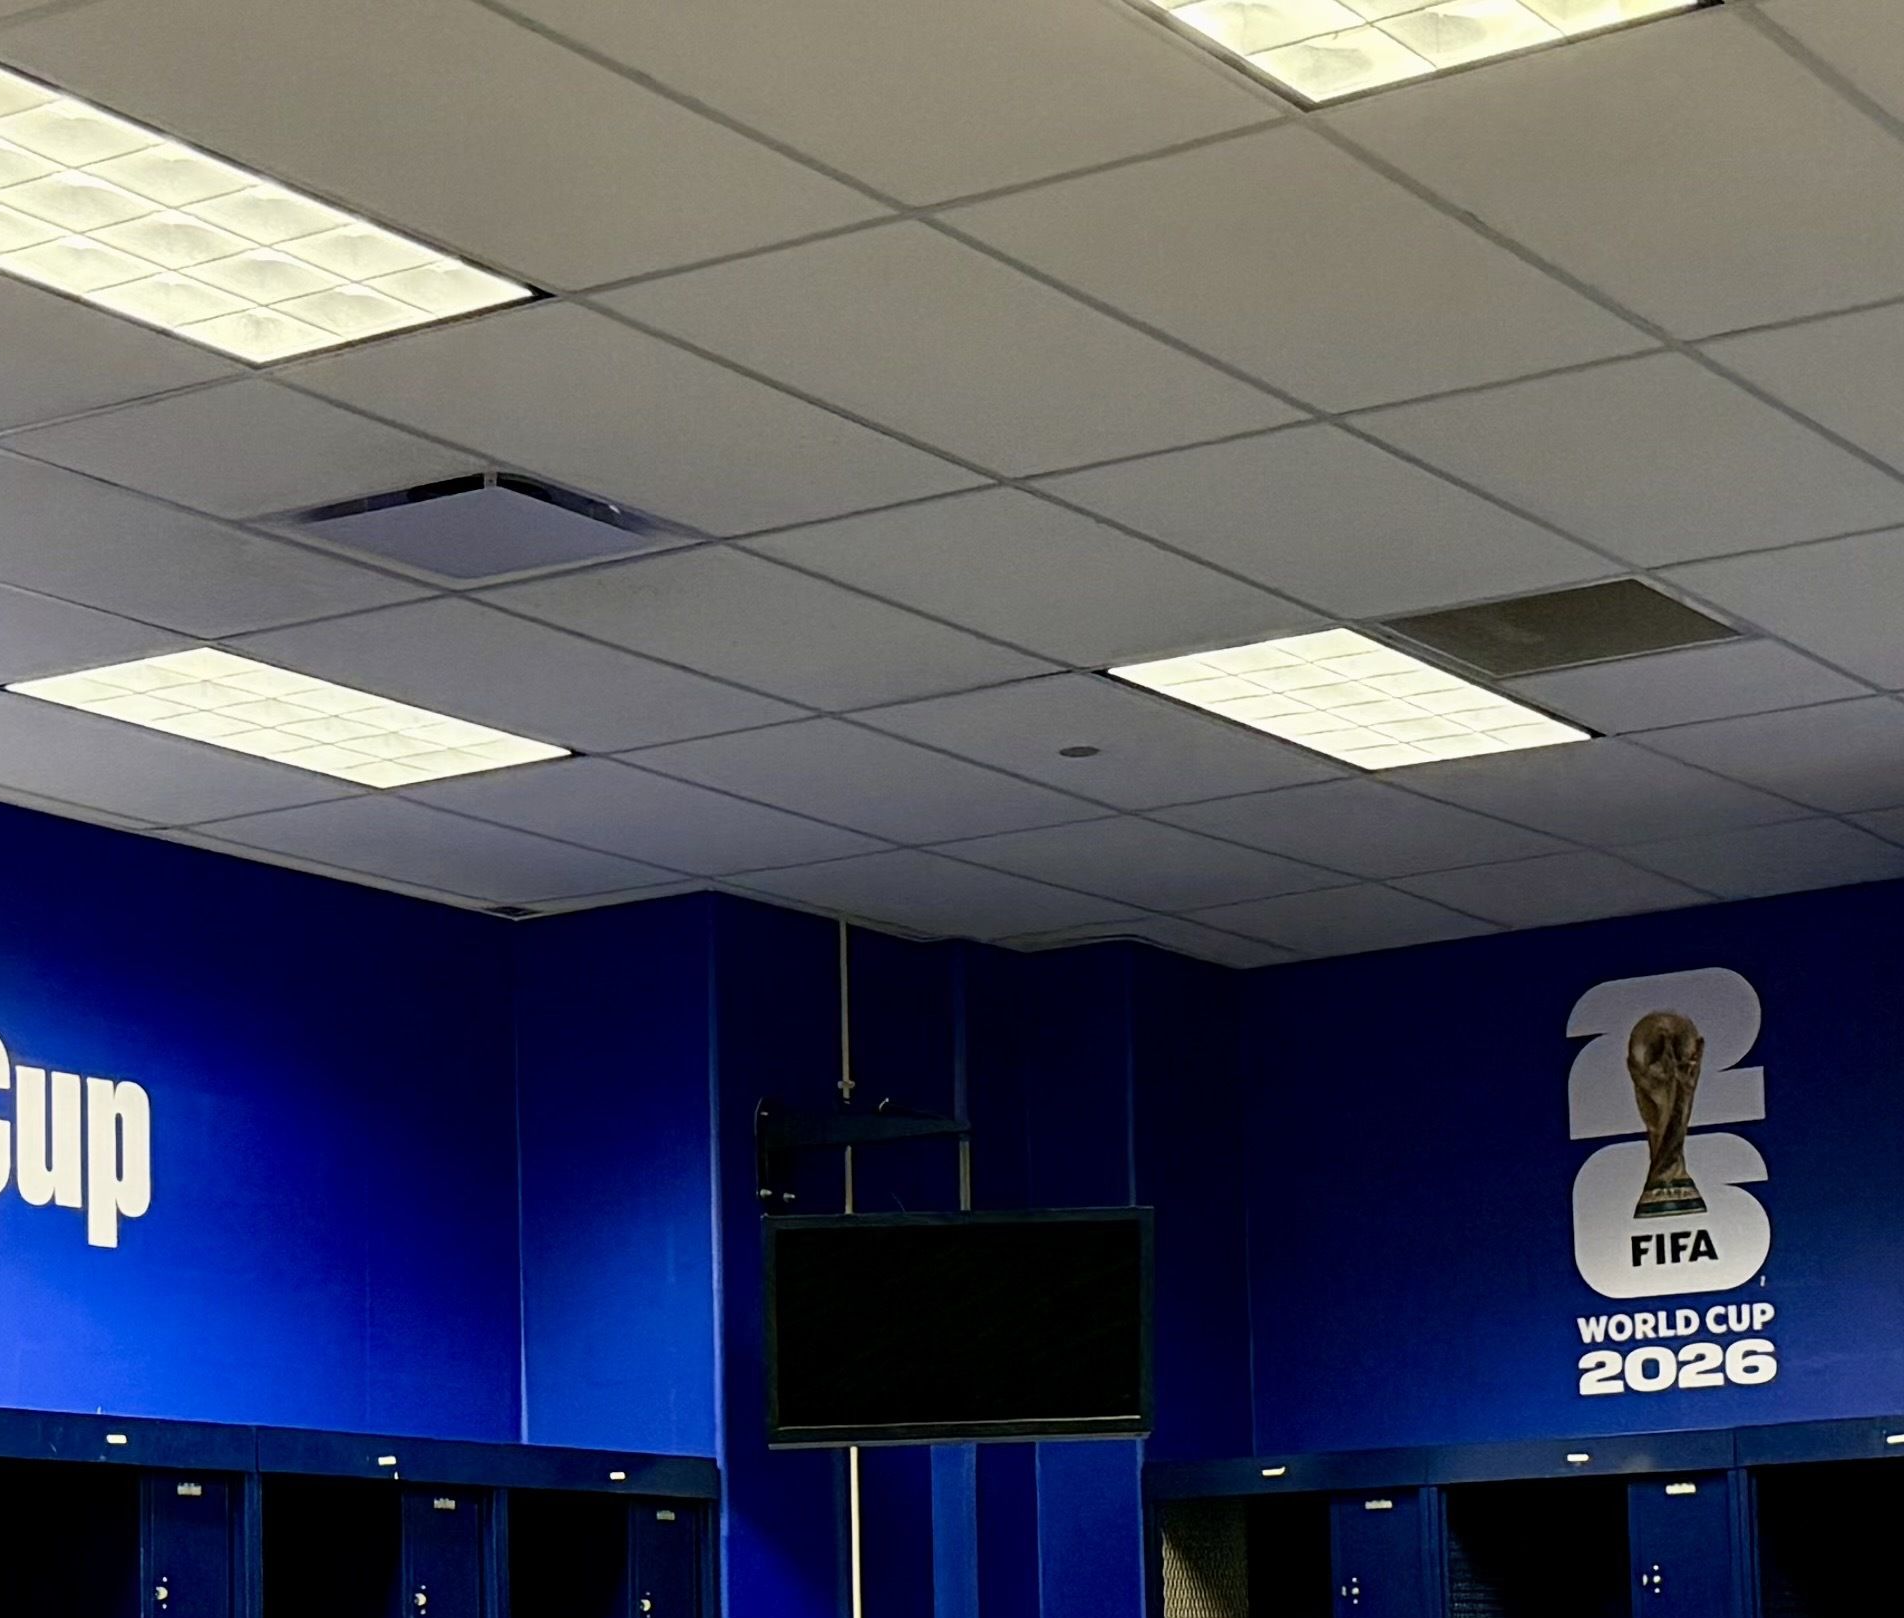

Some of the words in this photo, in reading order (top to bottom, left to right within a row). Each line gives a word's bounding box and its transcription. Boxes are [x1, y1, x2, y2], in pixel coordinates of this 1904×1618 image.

[1630, 1229, 1719, 1267] FIFA
[1576, 1308, 1700, 1344] WORLD
[1705, 1302, 1776, 1335] CUP
[1577, 1338, 1779, 1396] 2026
